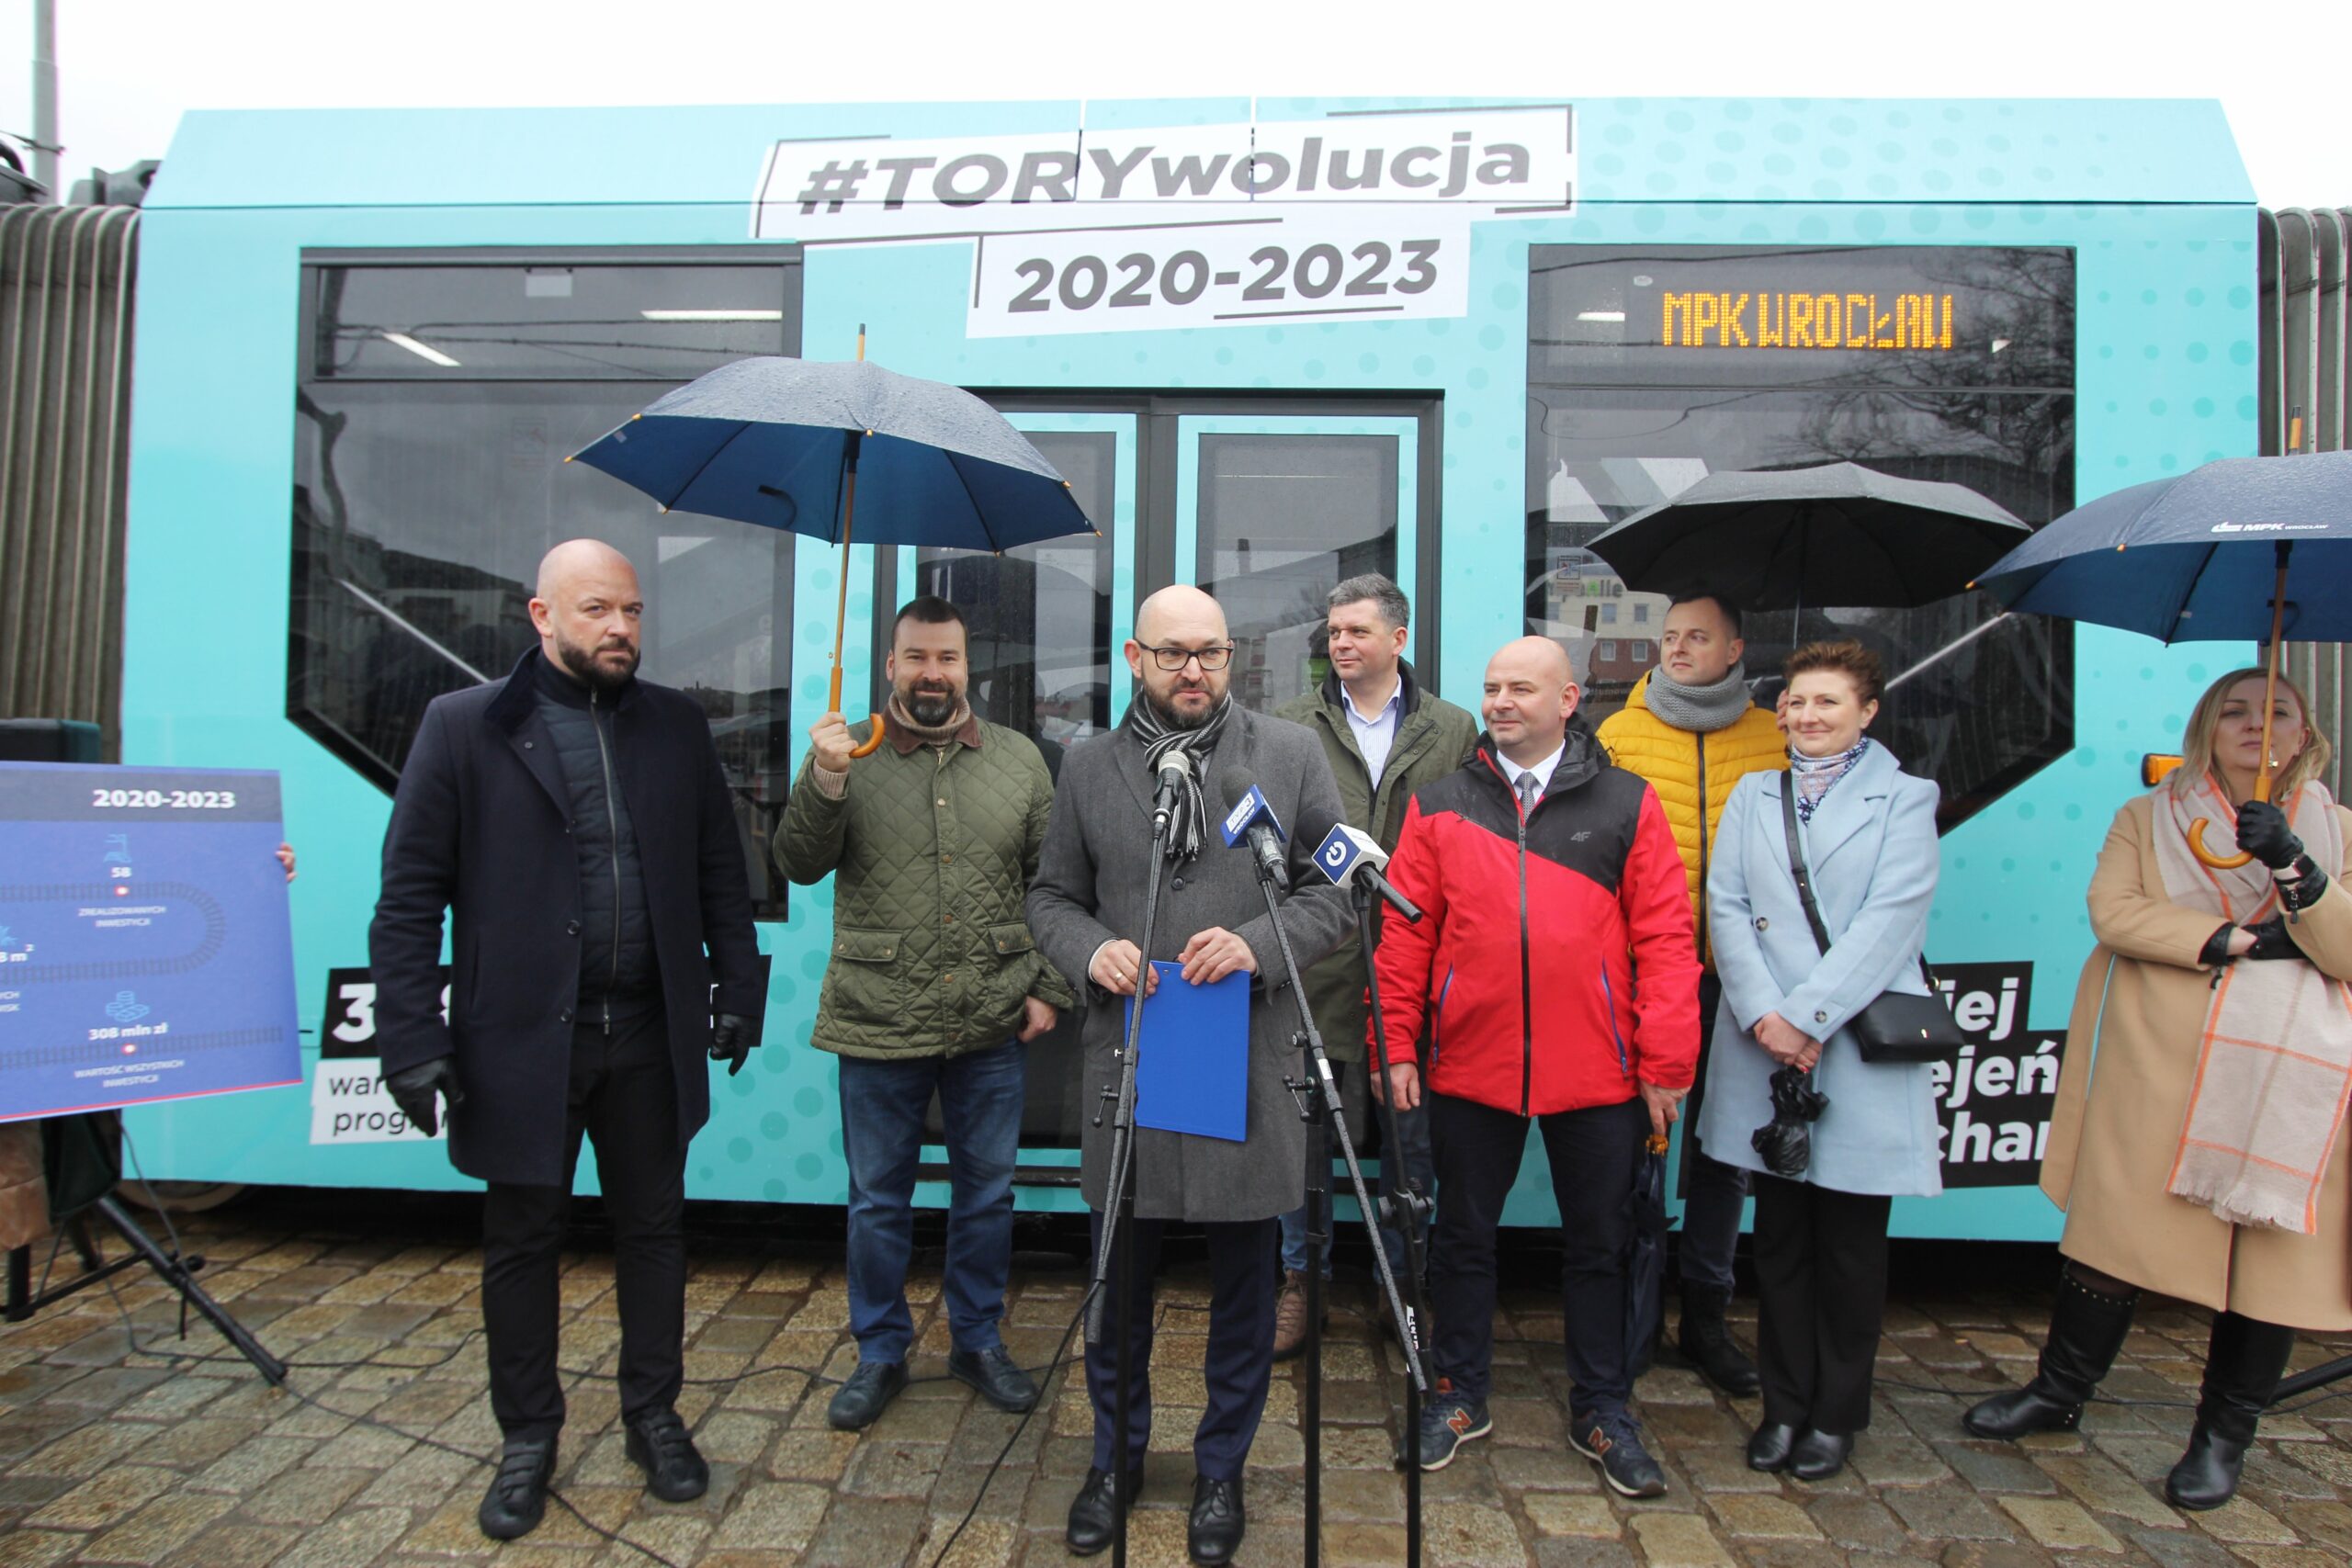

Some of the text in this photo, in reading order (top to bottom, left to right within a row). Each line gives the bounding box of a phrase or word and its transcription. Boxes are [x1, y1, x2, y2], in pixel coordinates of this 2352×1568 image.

[796, 131, 1531, 216] #TORYwolucja
[1007, 239, 1441, 313] 2020-2023
[1664, 293, 1749, 346] MPK
[2243, 523, 2285, 531] MPK
[93, 789, 236, 808] 2020-2023
[1570, 831, 1591, 841] 4F
[111, 867, 132, 878] 58
[88, 1027, 119, 1041] 308
